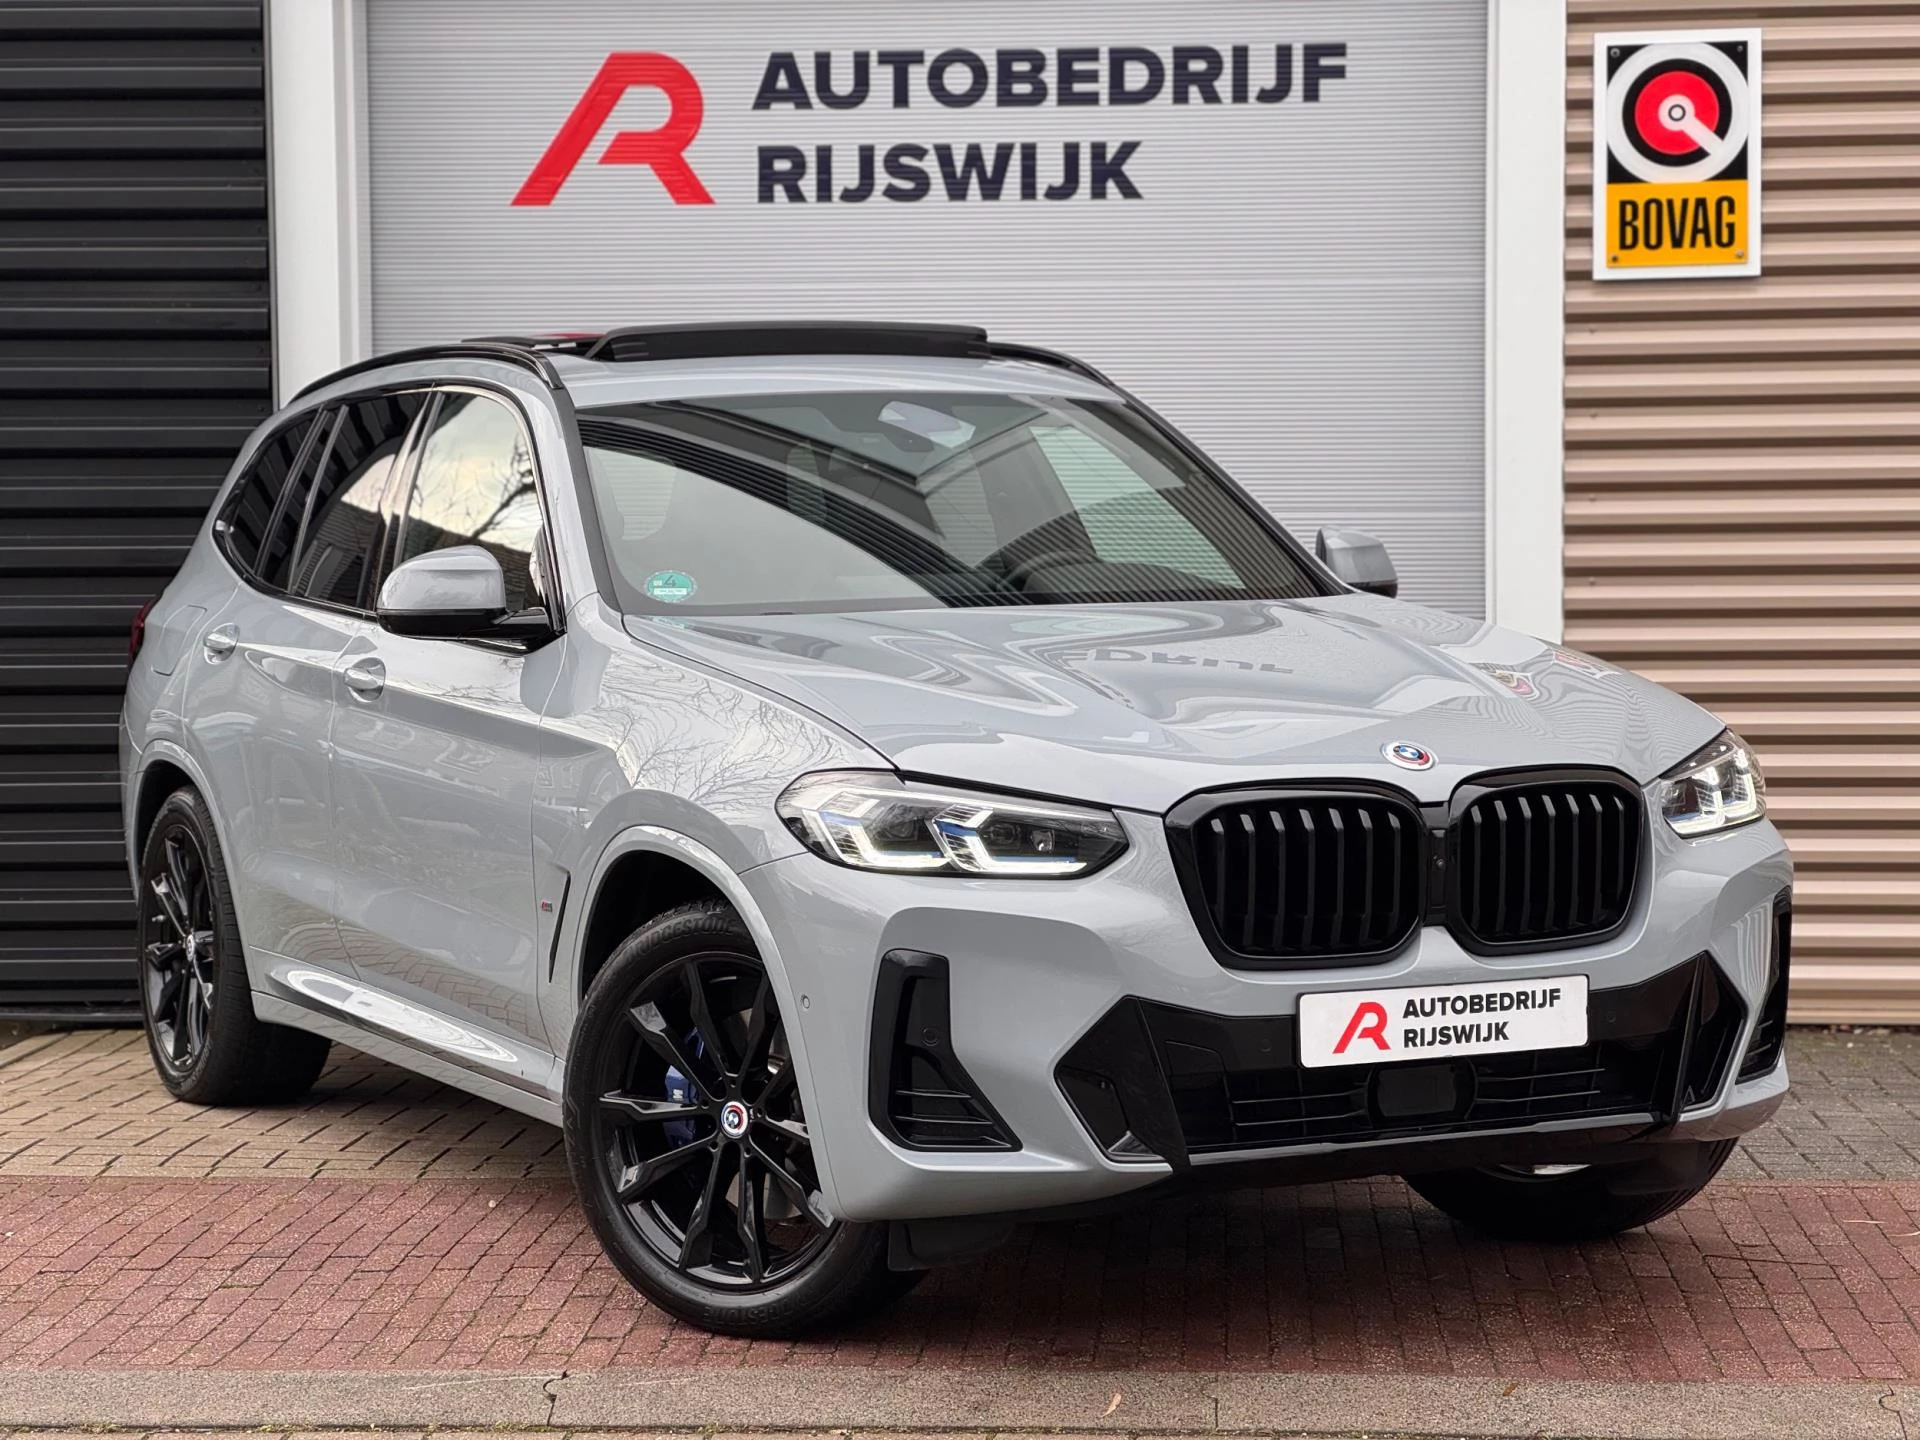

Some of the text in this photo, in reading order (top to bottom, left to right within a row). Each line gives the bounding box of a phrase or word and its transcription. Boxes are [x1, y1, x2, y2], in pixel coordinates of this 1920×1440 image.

[752, 43, 1347, 110] AUTOBEDRIJF
[757, 141, 1143, 203] RIJSWIJK
[1619, 196, 1735, 250] BOVAG
[1403, 988, 1561, 1019] AUTOBEDRIJF
[1403, 1022, 1509, 1049] RIJSWIJK
